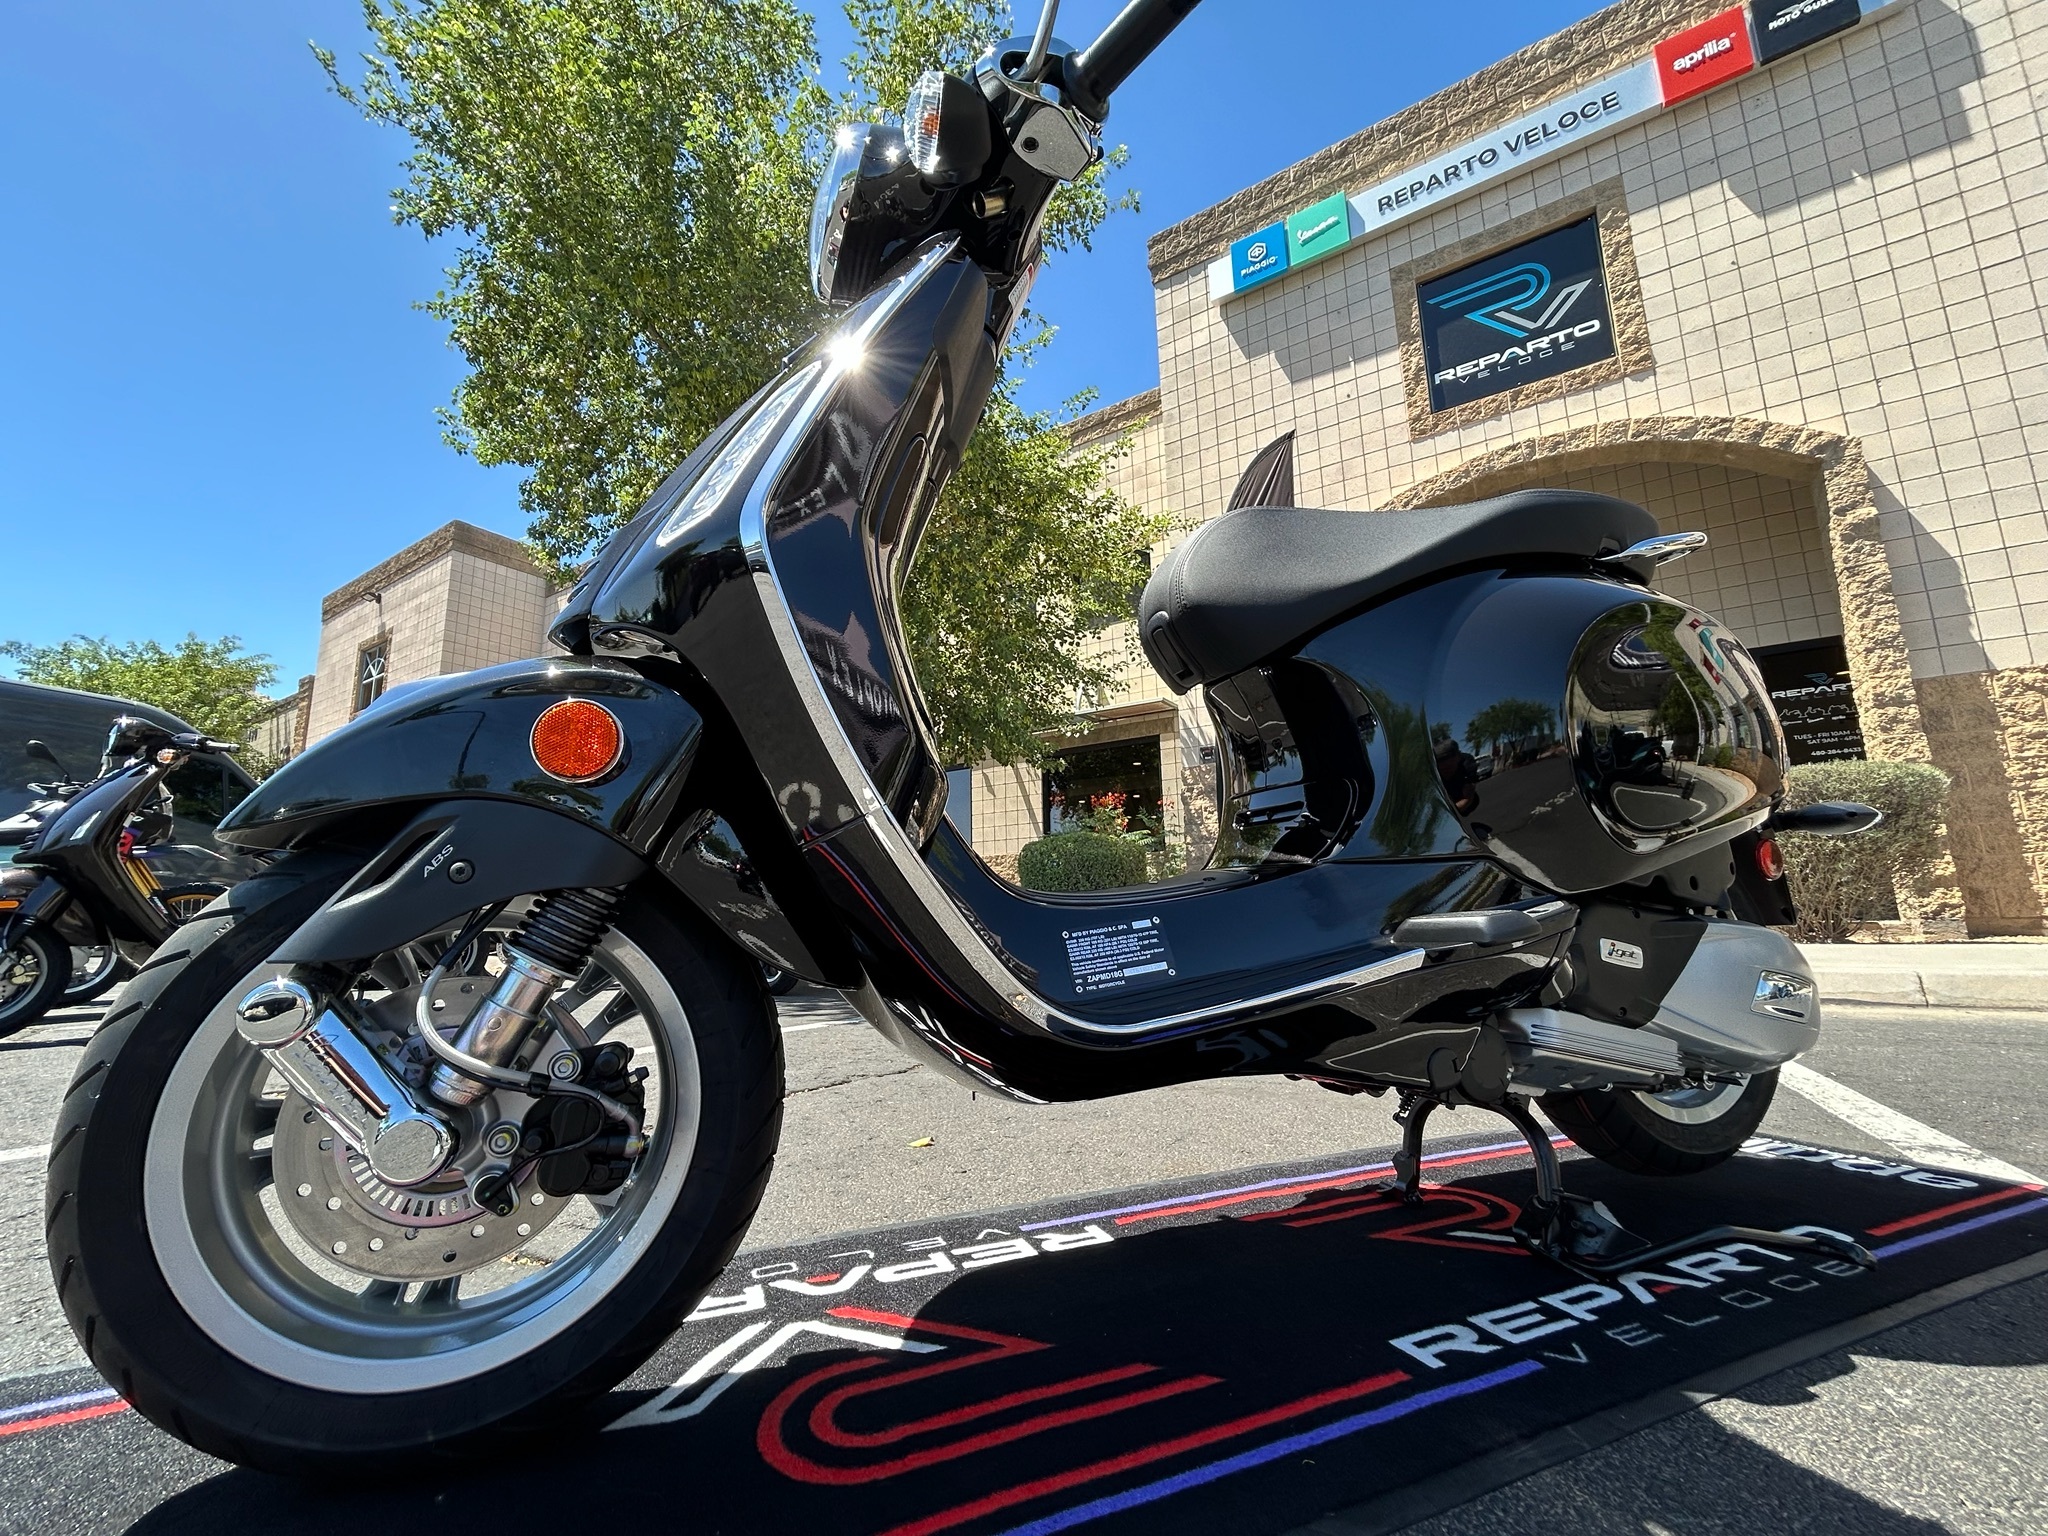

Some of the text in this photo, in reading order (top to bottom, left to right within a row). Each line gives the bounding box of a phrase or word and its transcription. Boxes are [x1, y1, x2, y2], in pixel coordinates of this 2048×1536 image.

[1768, 0, 1834, 30] MOTO GUZ
[1672, 36, 1731, 71] aprilia
[1378, 91, 1620, 213] REPARTO VELOCE
[1240, 257, 1277, 277] PIAGGIO
[1434, 319, 1601, 384] REPARTO
[1459, 341, 1575, 384] VELOCE
[1771, 683, 1851, 698] REPAR
[1788, 691, 1850, 701] VELOC
[424, 844, 453, 878] ABS
[752, 1229, 1010, 1278] VELO
[682, 1224, 1115, 1322] REPAR
